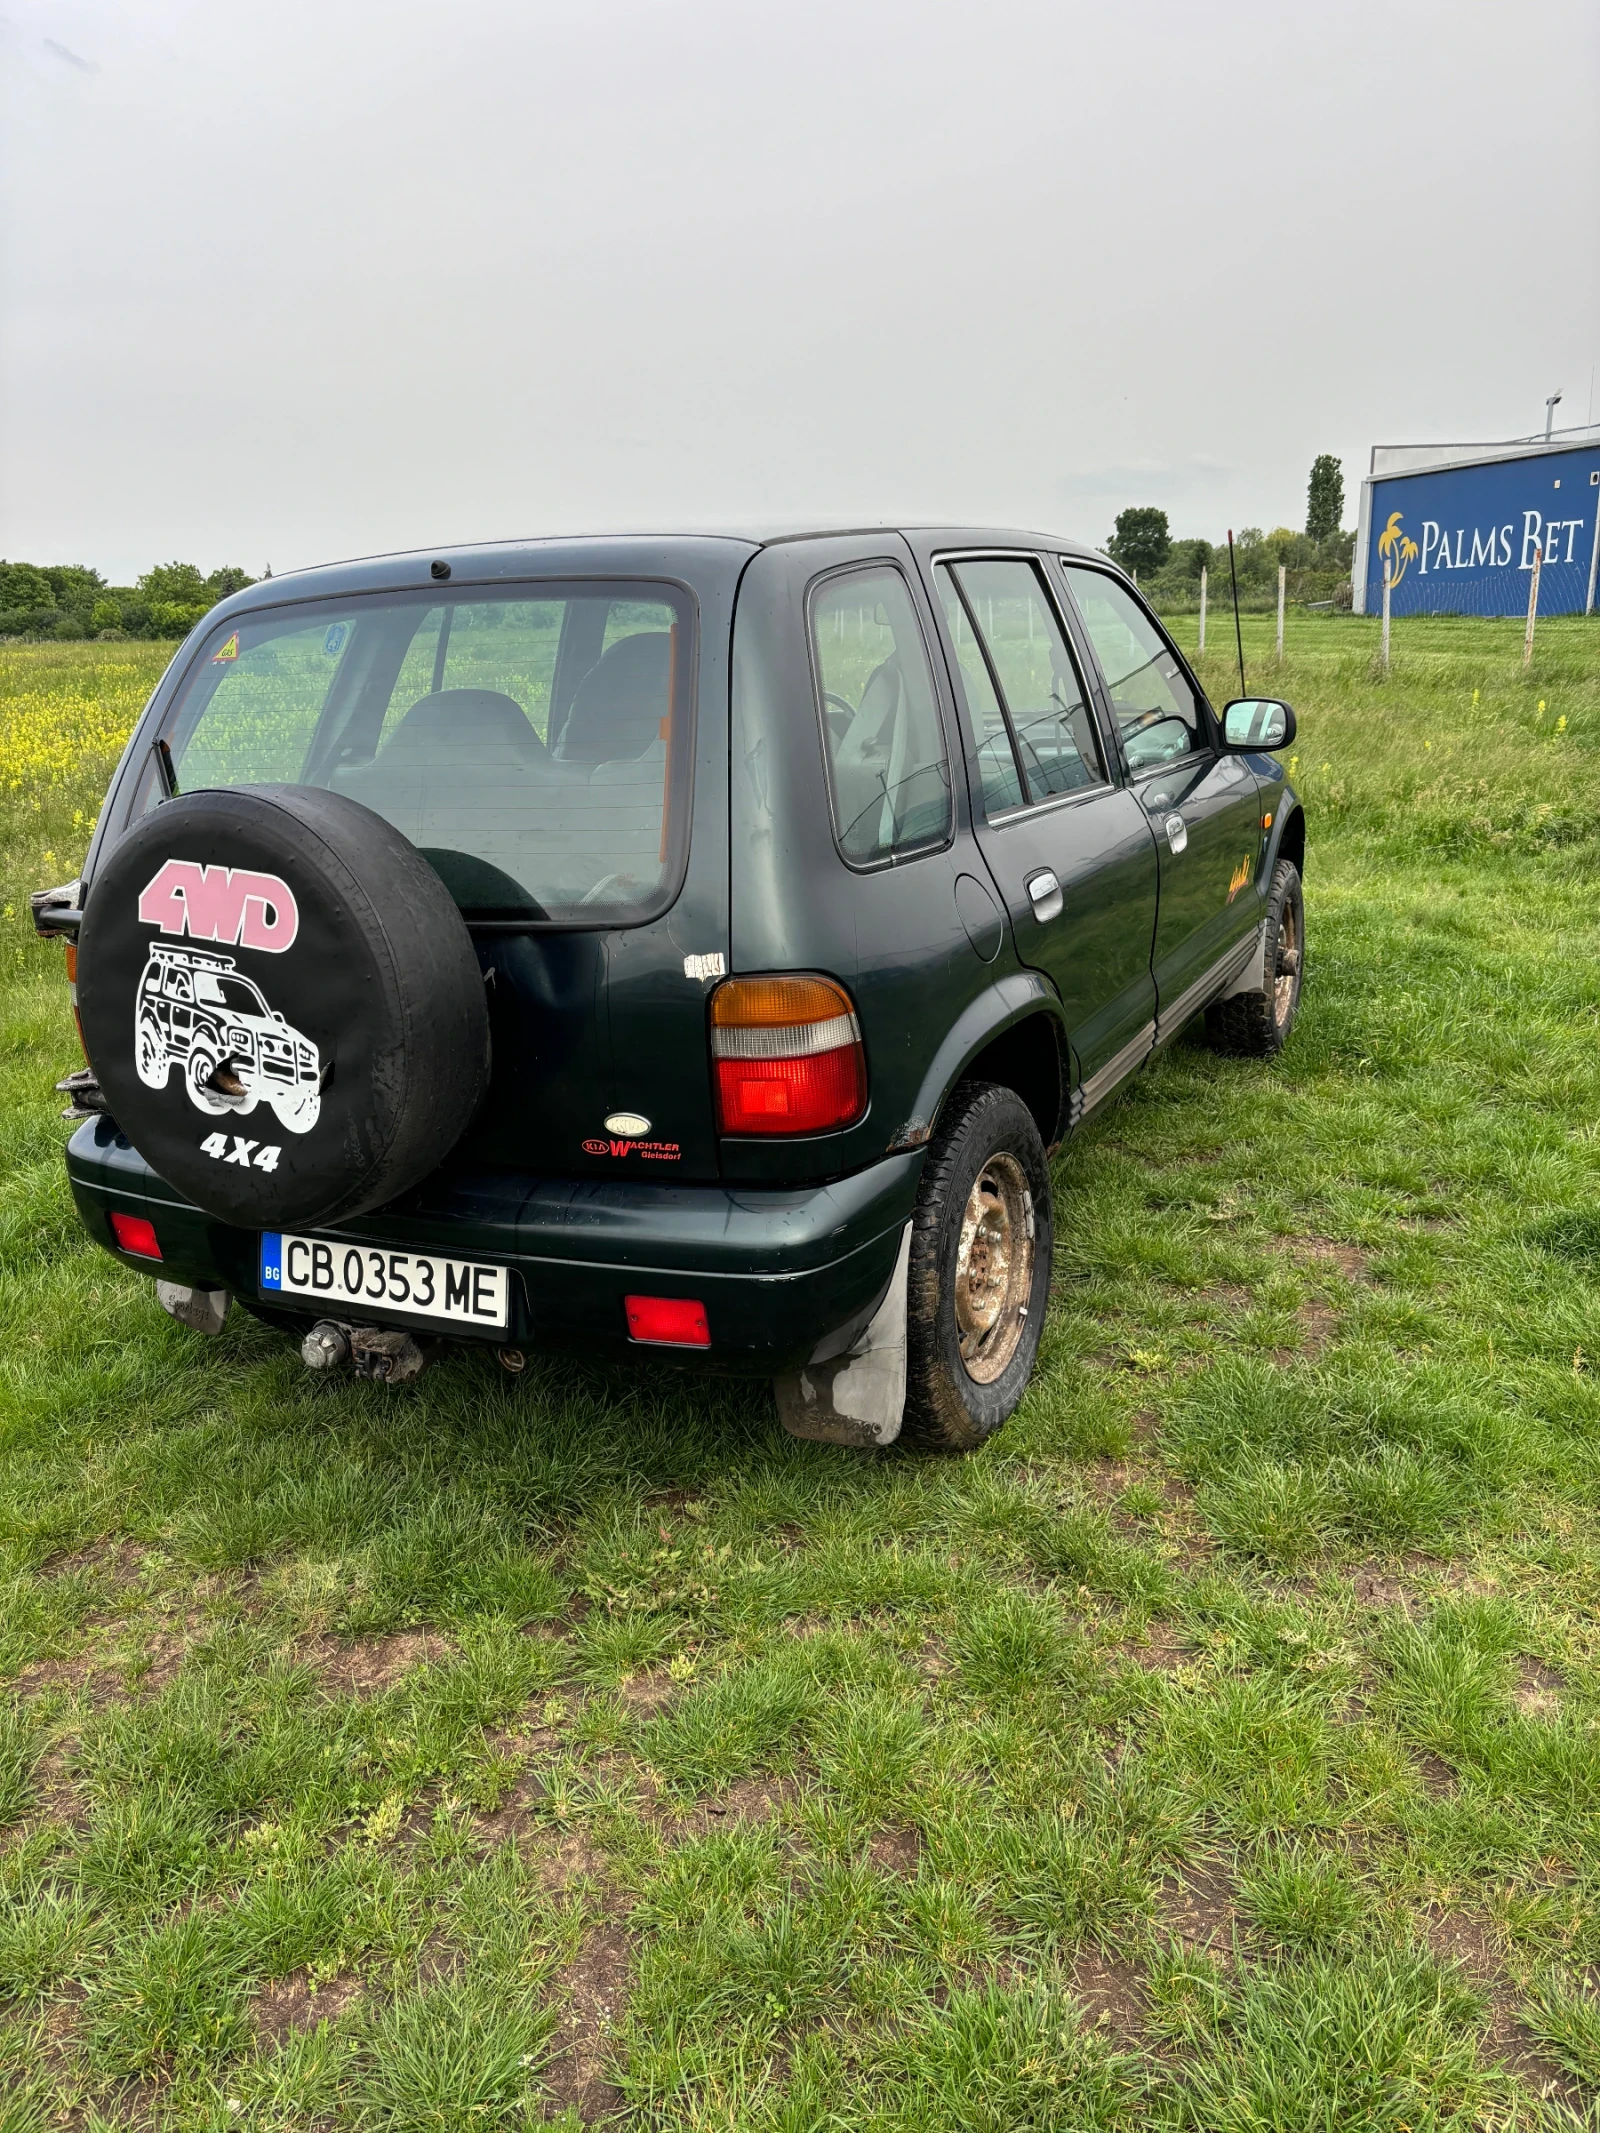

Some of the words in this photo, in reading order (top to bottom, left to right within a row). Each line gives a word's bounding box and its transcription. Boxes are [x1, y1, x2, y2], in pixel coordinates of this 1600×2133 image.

[1418, 521, 1513, 574] PALMS
[1518, 510, 1583, 570] BET
[139, 859, 299, 953] 4WD
[200, 1132, 282, 1173] 4X4
[610, 1140, 679, 1157] WACHTLER
[641, 1151, 681, 1160] Gleisdorf
[265, 1266, 280, 1280] BG
[343, 1249, 435, 1306] 0353
[445, 1262, 498, 1317] ME
